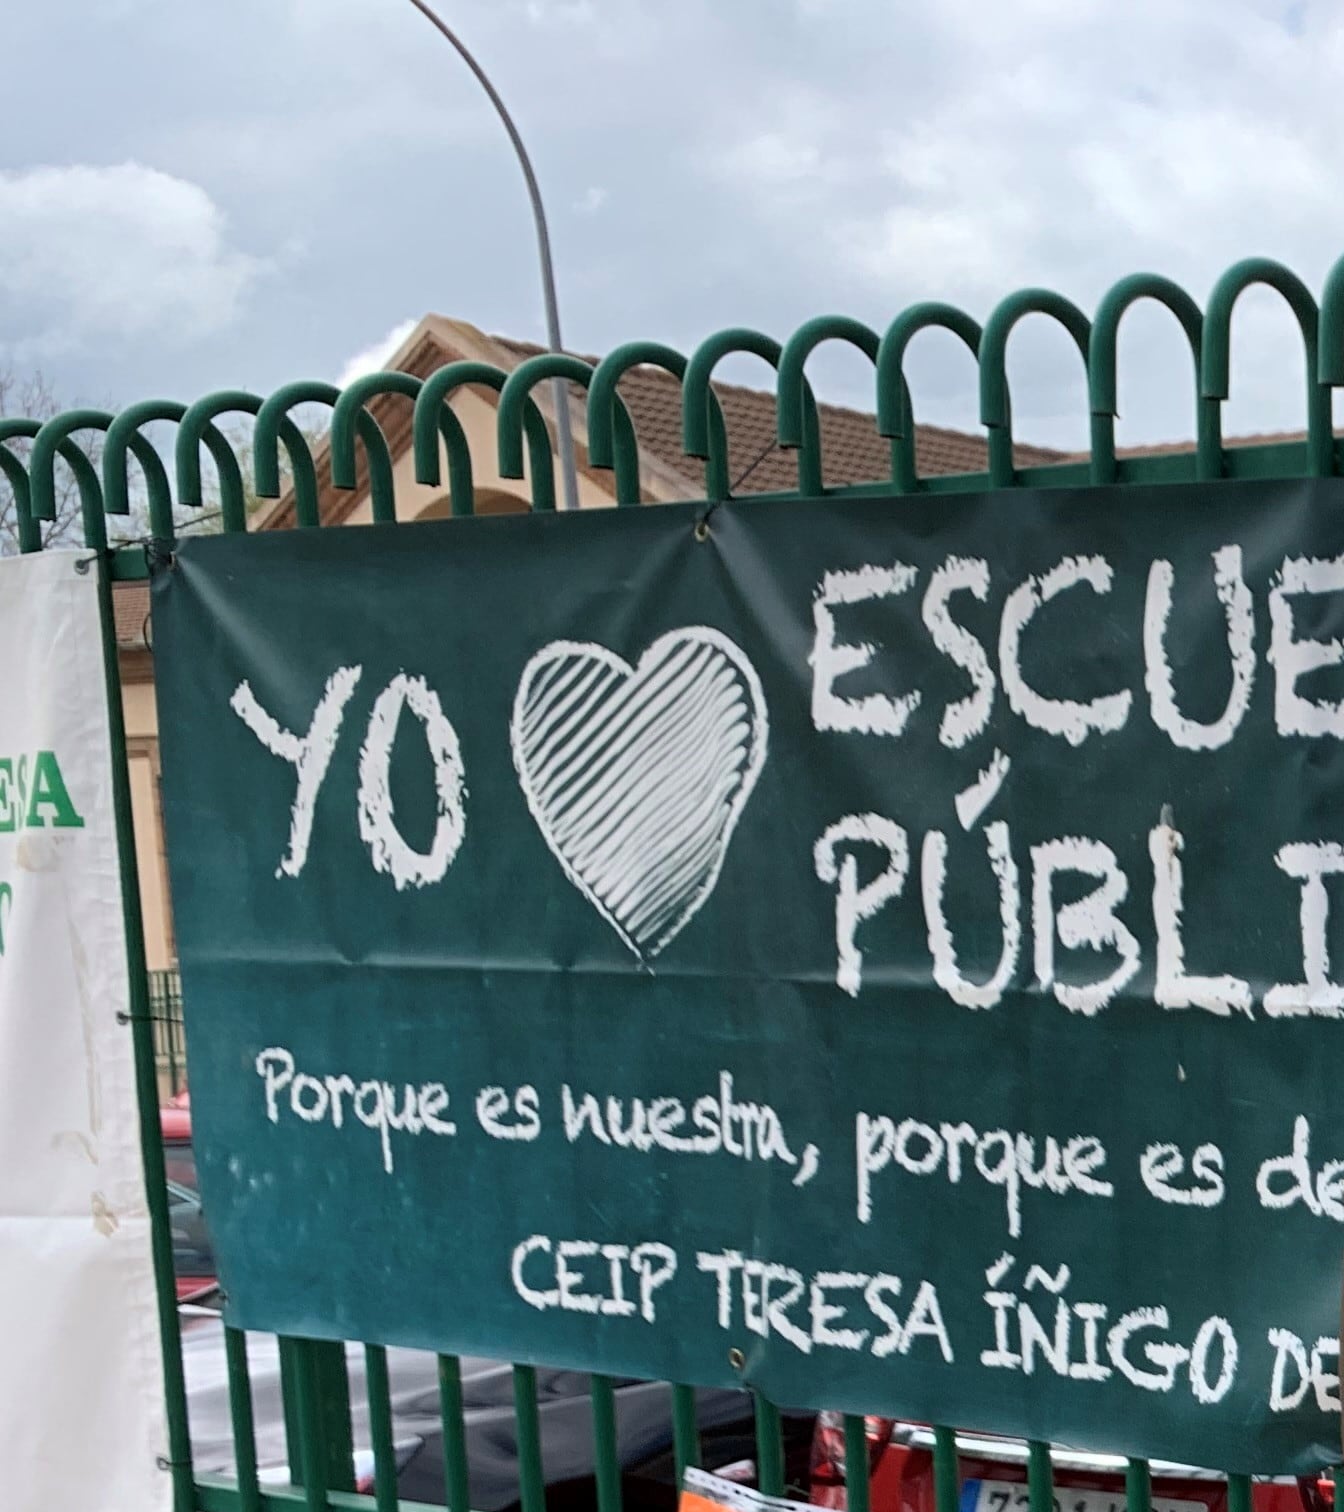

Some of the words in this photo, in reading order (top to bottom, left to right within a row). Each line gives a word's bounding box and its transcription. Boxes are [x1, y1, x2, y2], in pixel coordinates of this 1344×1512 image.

[231, 663, 469, 892] YO
[255, 1046, 457, 1174] Porque
[475, 1083, 541, 1142] es
[561, 1069, 820, 1188] nuestra,
[856, 1110, 1115, 1239] porque
[1139, 1140, 1226, 1208] es
[510, 1233, 679, 1324] CEIP
[696, 1248, 955, 1364] TERESA
[981, 1250, 1240, 1406] ÍÑIGO
